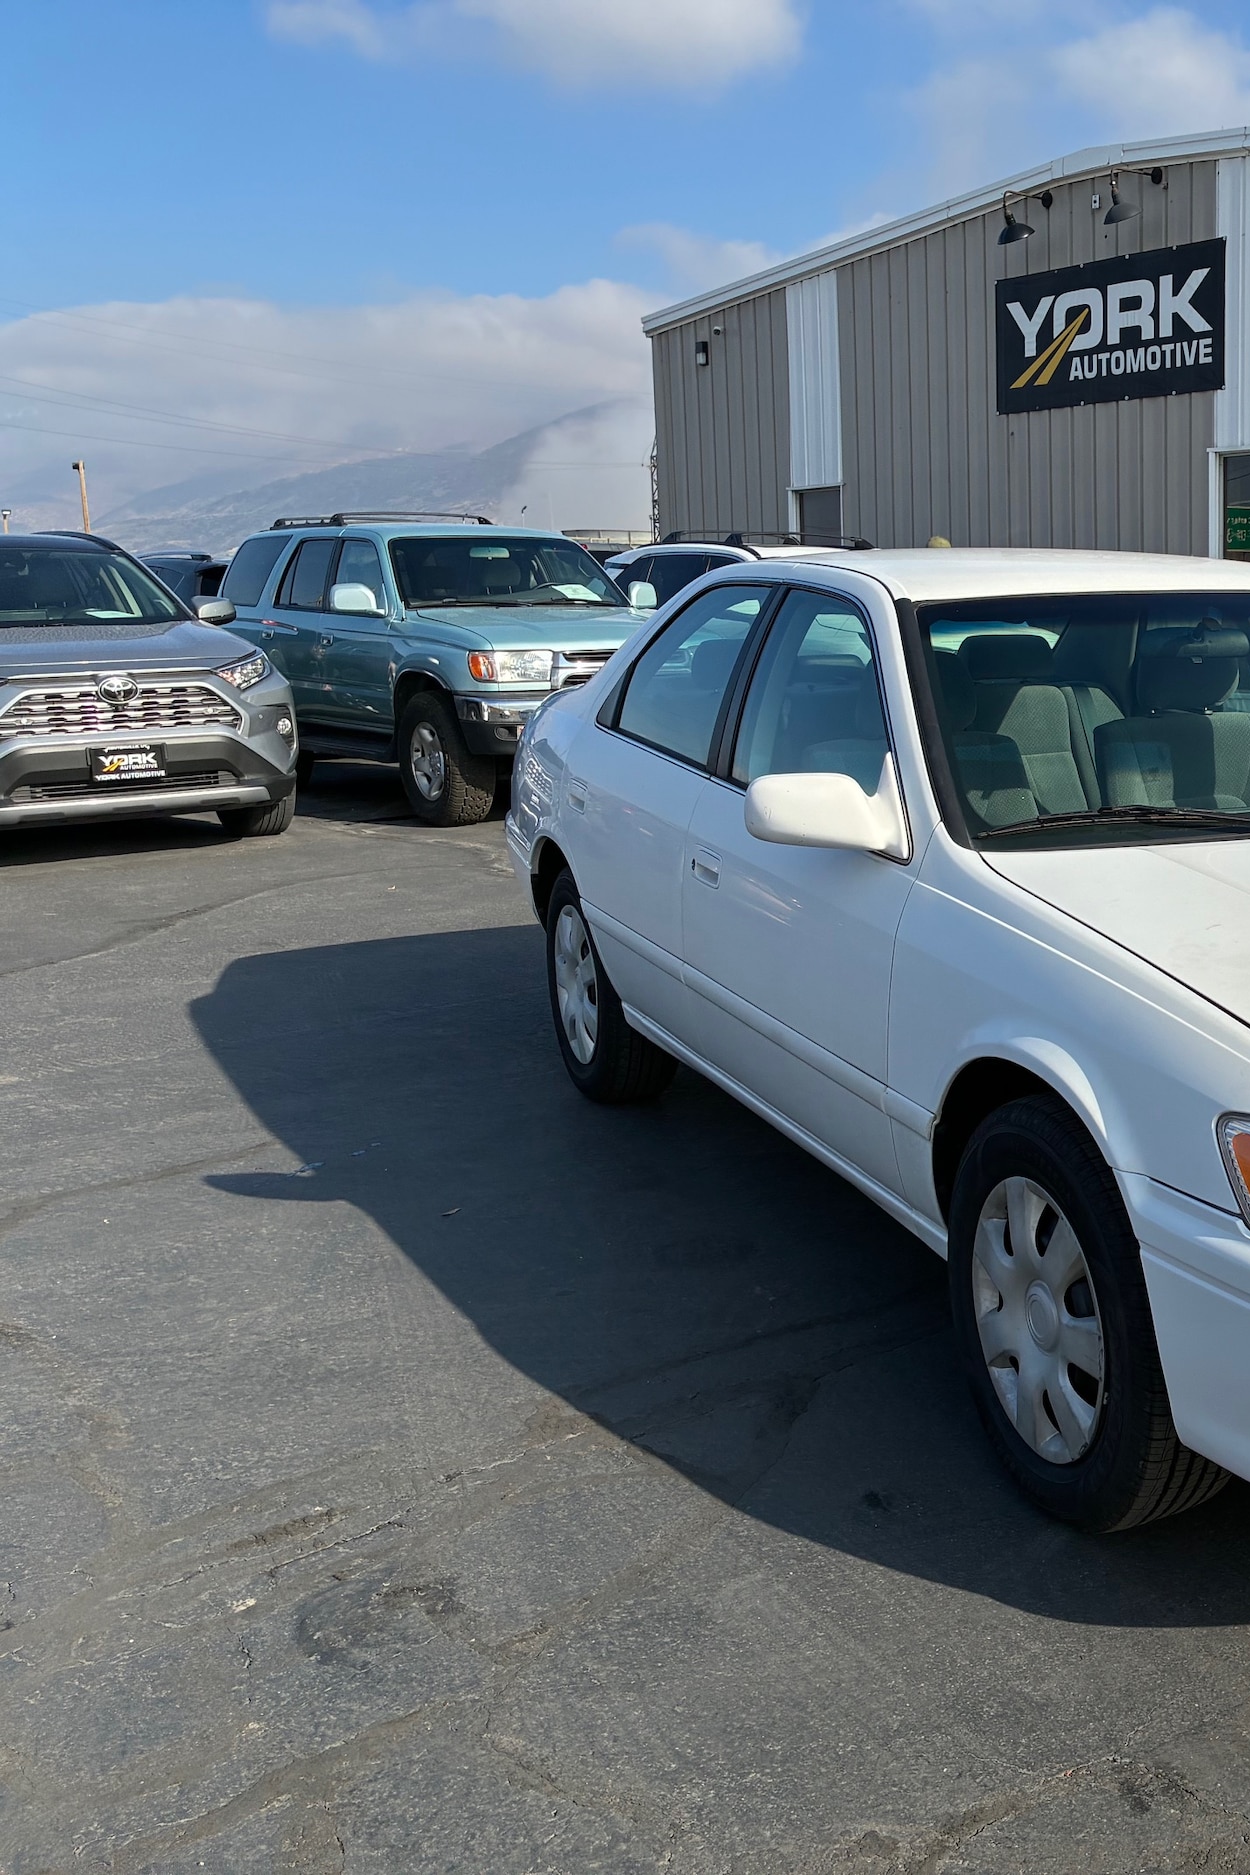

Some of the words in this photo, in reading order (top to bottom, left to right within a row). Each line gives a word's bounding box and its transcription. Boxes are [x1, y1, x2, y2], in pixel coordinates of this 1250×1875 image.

[1005, 267, 1213, 358] YORK
[1069, 337, 1213, 381] AUTOMOTIVE
[98, 752, 157, 767] YORK
[120, 769, 166, 779] AUTOMOTIVE
